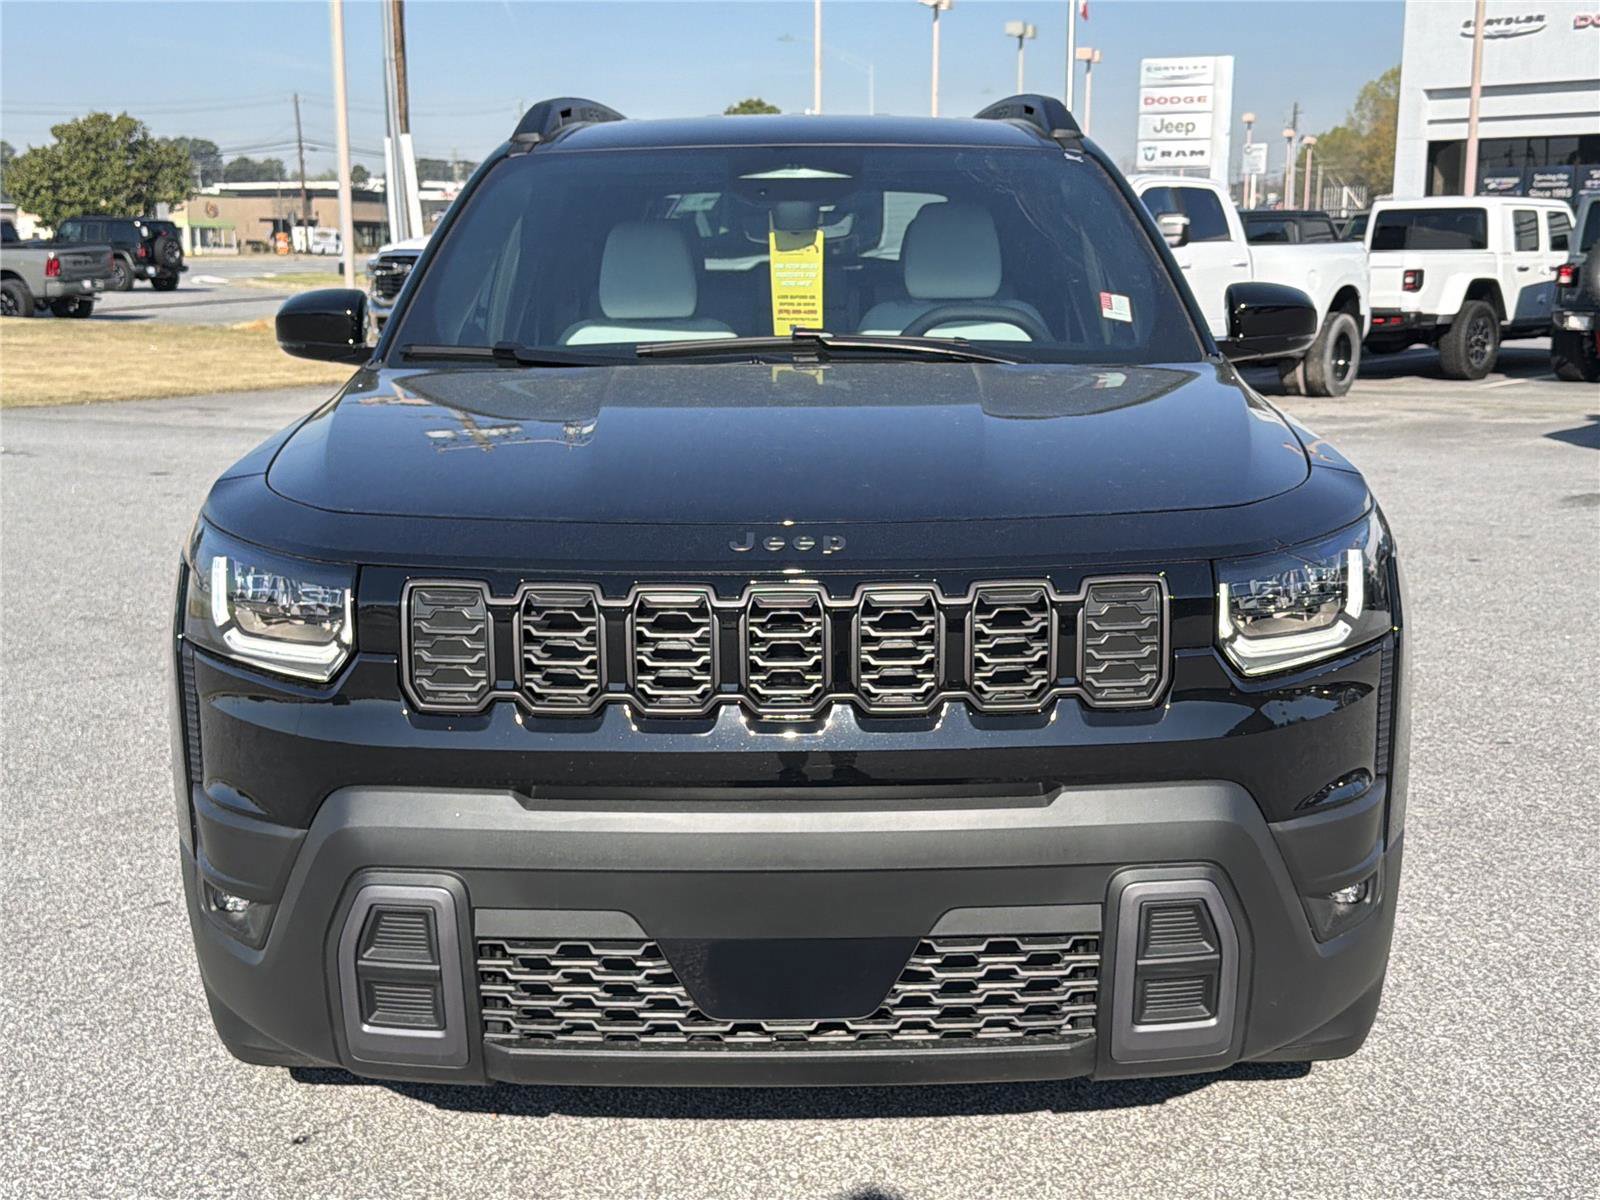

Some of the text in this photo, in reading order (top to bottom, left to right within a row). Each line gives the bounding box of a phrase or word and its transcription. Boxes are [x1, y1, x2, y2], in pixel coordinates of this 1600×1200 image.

[1462, 14, 1545, 28] CRYSLER
[1143, 95, 1207, 105] DODGE
[1153, 118, 1196, 136] Jeep
[1160, 150, 1205, 158] RAM
[729, 532, 846, 554] Jeep
